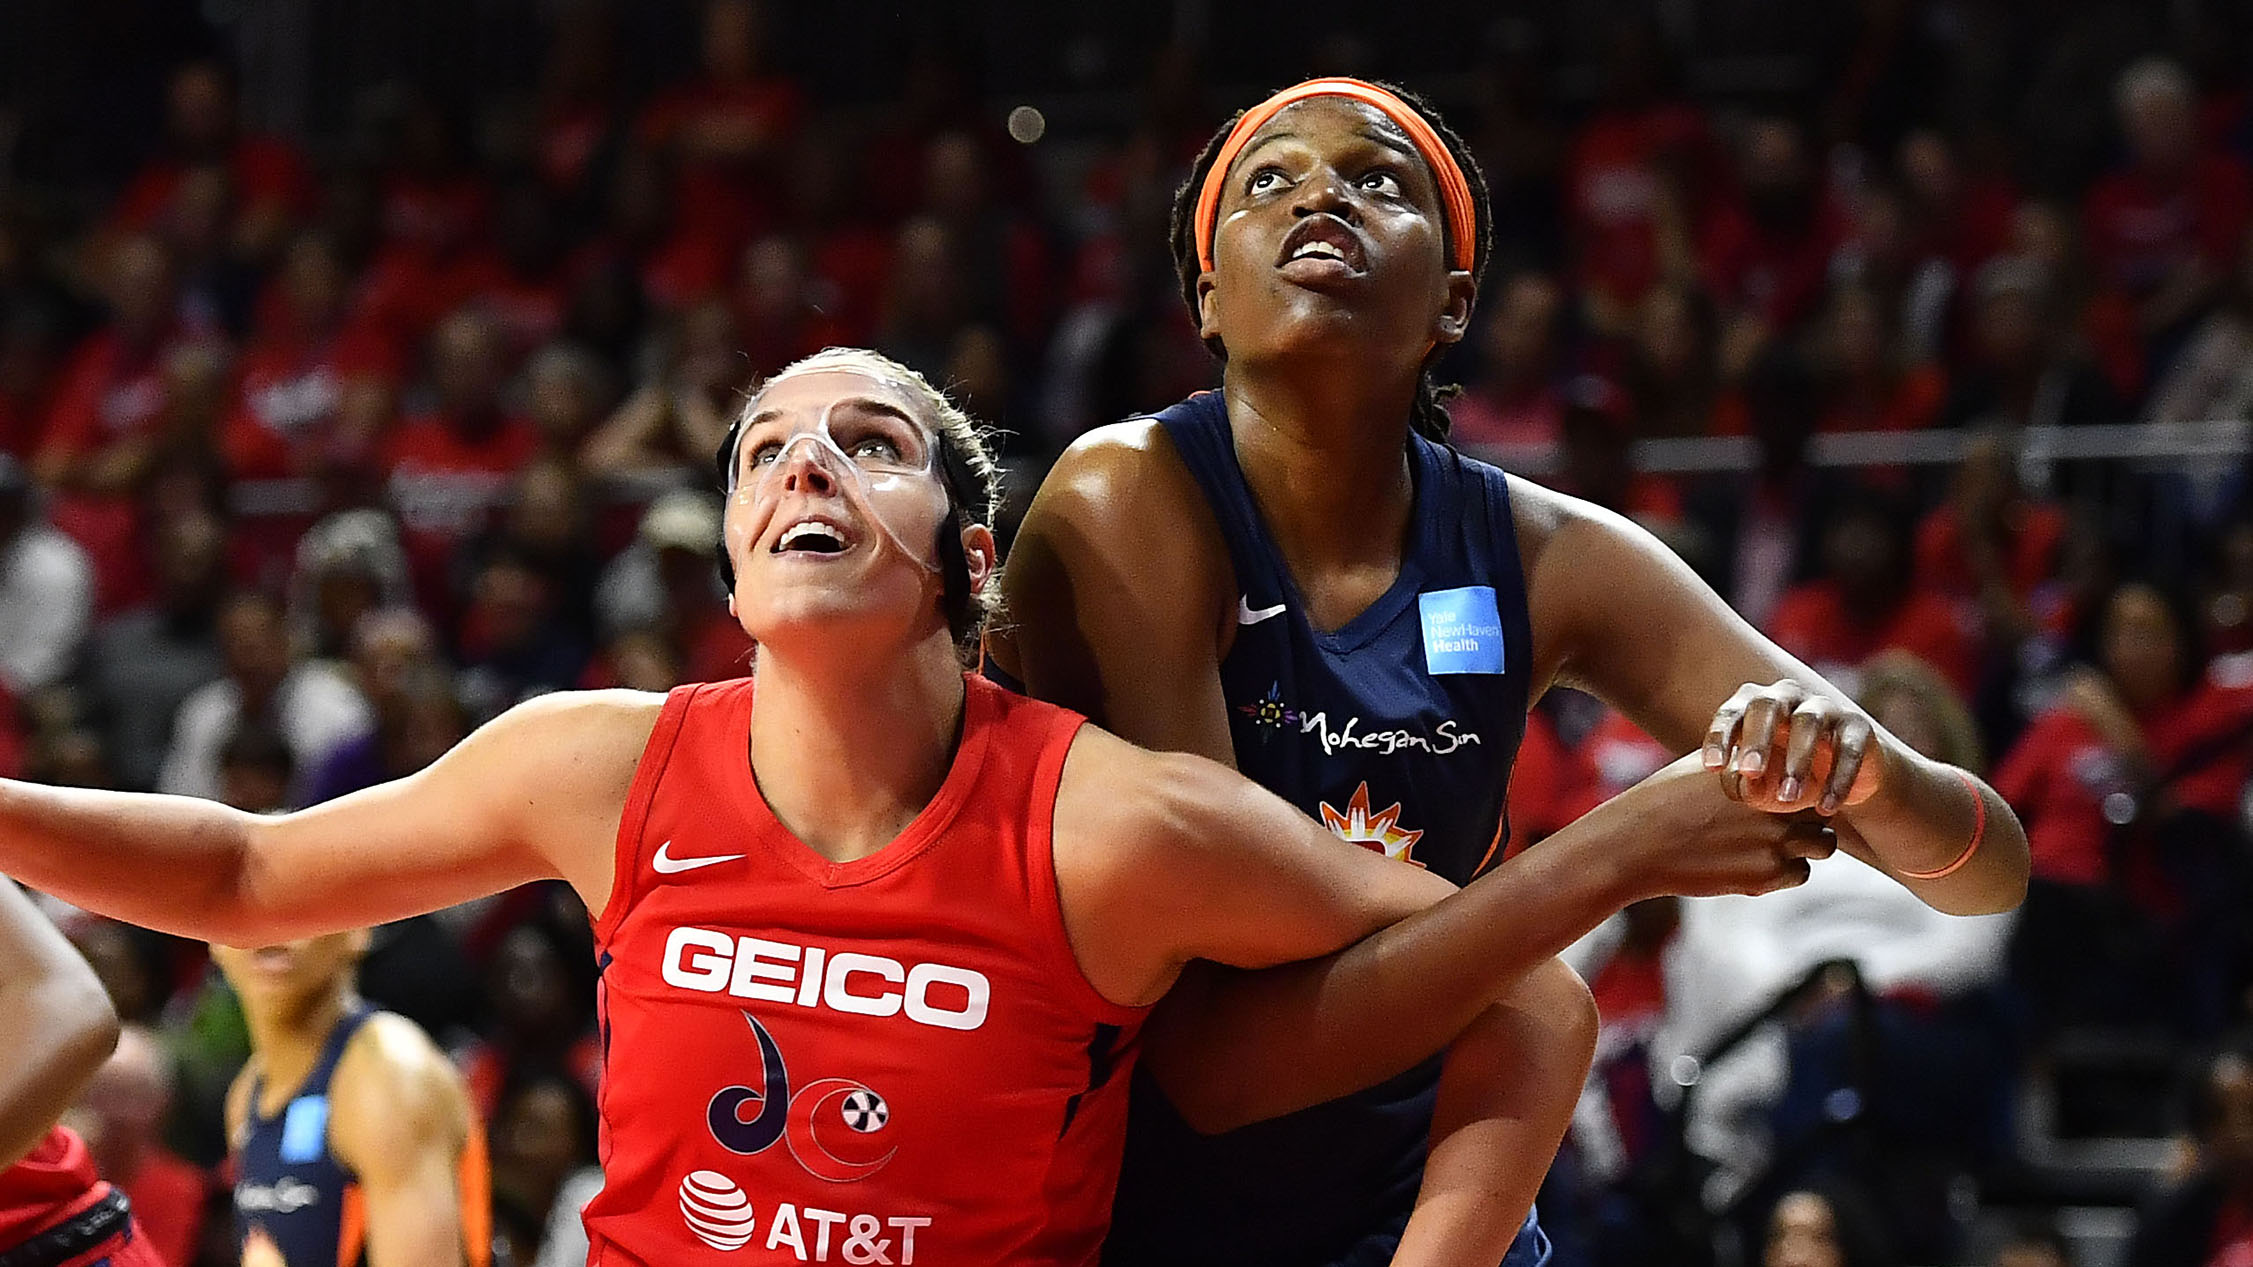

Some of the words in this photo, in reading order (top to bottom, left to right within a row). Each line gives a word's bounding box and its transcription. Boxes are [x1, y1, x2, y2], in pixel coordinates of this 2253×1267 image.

[1428, 611, 1456, 624] Yale
[1433, 638, 1479, 653] Health
[1300, 711, 1431, 755] Mohegan
[661, 926, 991, 1030] GEICO
[766, 1203, 932, 1265] AT&T
